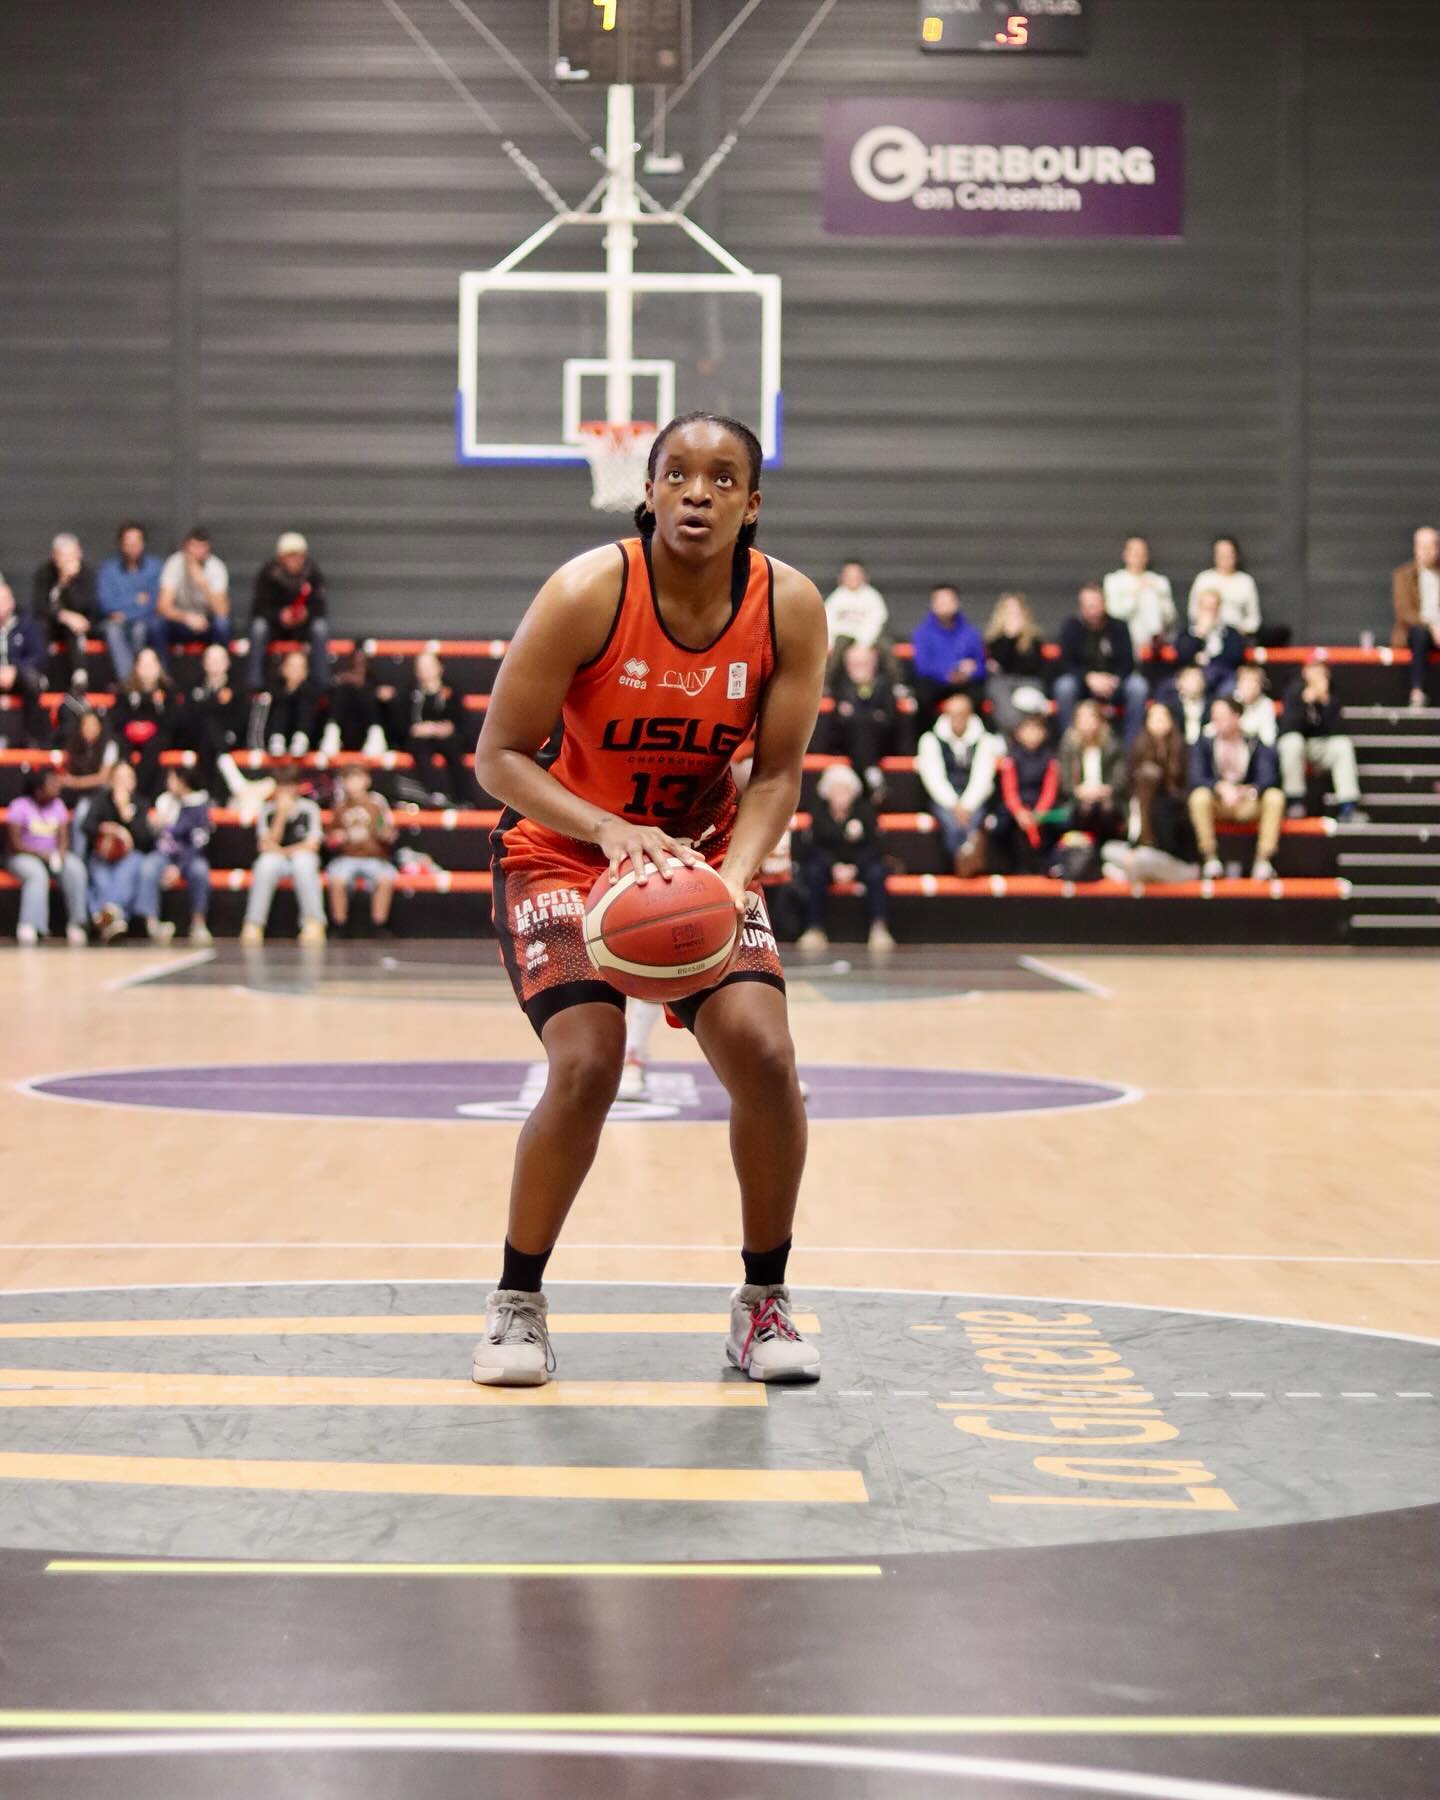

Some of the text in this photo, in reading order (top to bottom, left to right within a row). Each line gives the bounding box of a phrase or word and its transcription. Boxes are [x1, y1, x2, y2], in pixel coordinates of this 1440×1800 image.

[850, 125, 1155, 202] CHERBOURG
[912, 182, 1082, 212] en Cotentin
[661, 667, 715, 693] CMN
[601, 717, 745, 755] USLG
[623, 771, 701, 818] 13
[514, 899, 534, 919] LA
[551, 902, 586, 918] MER
